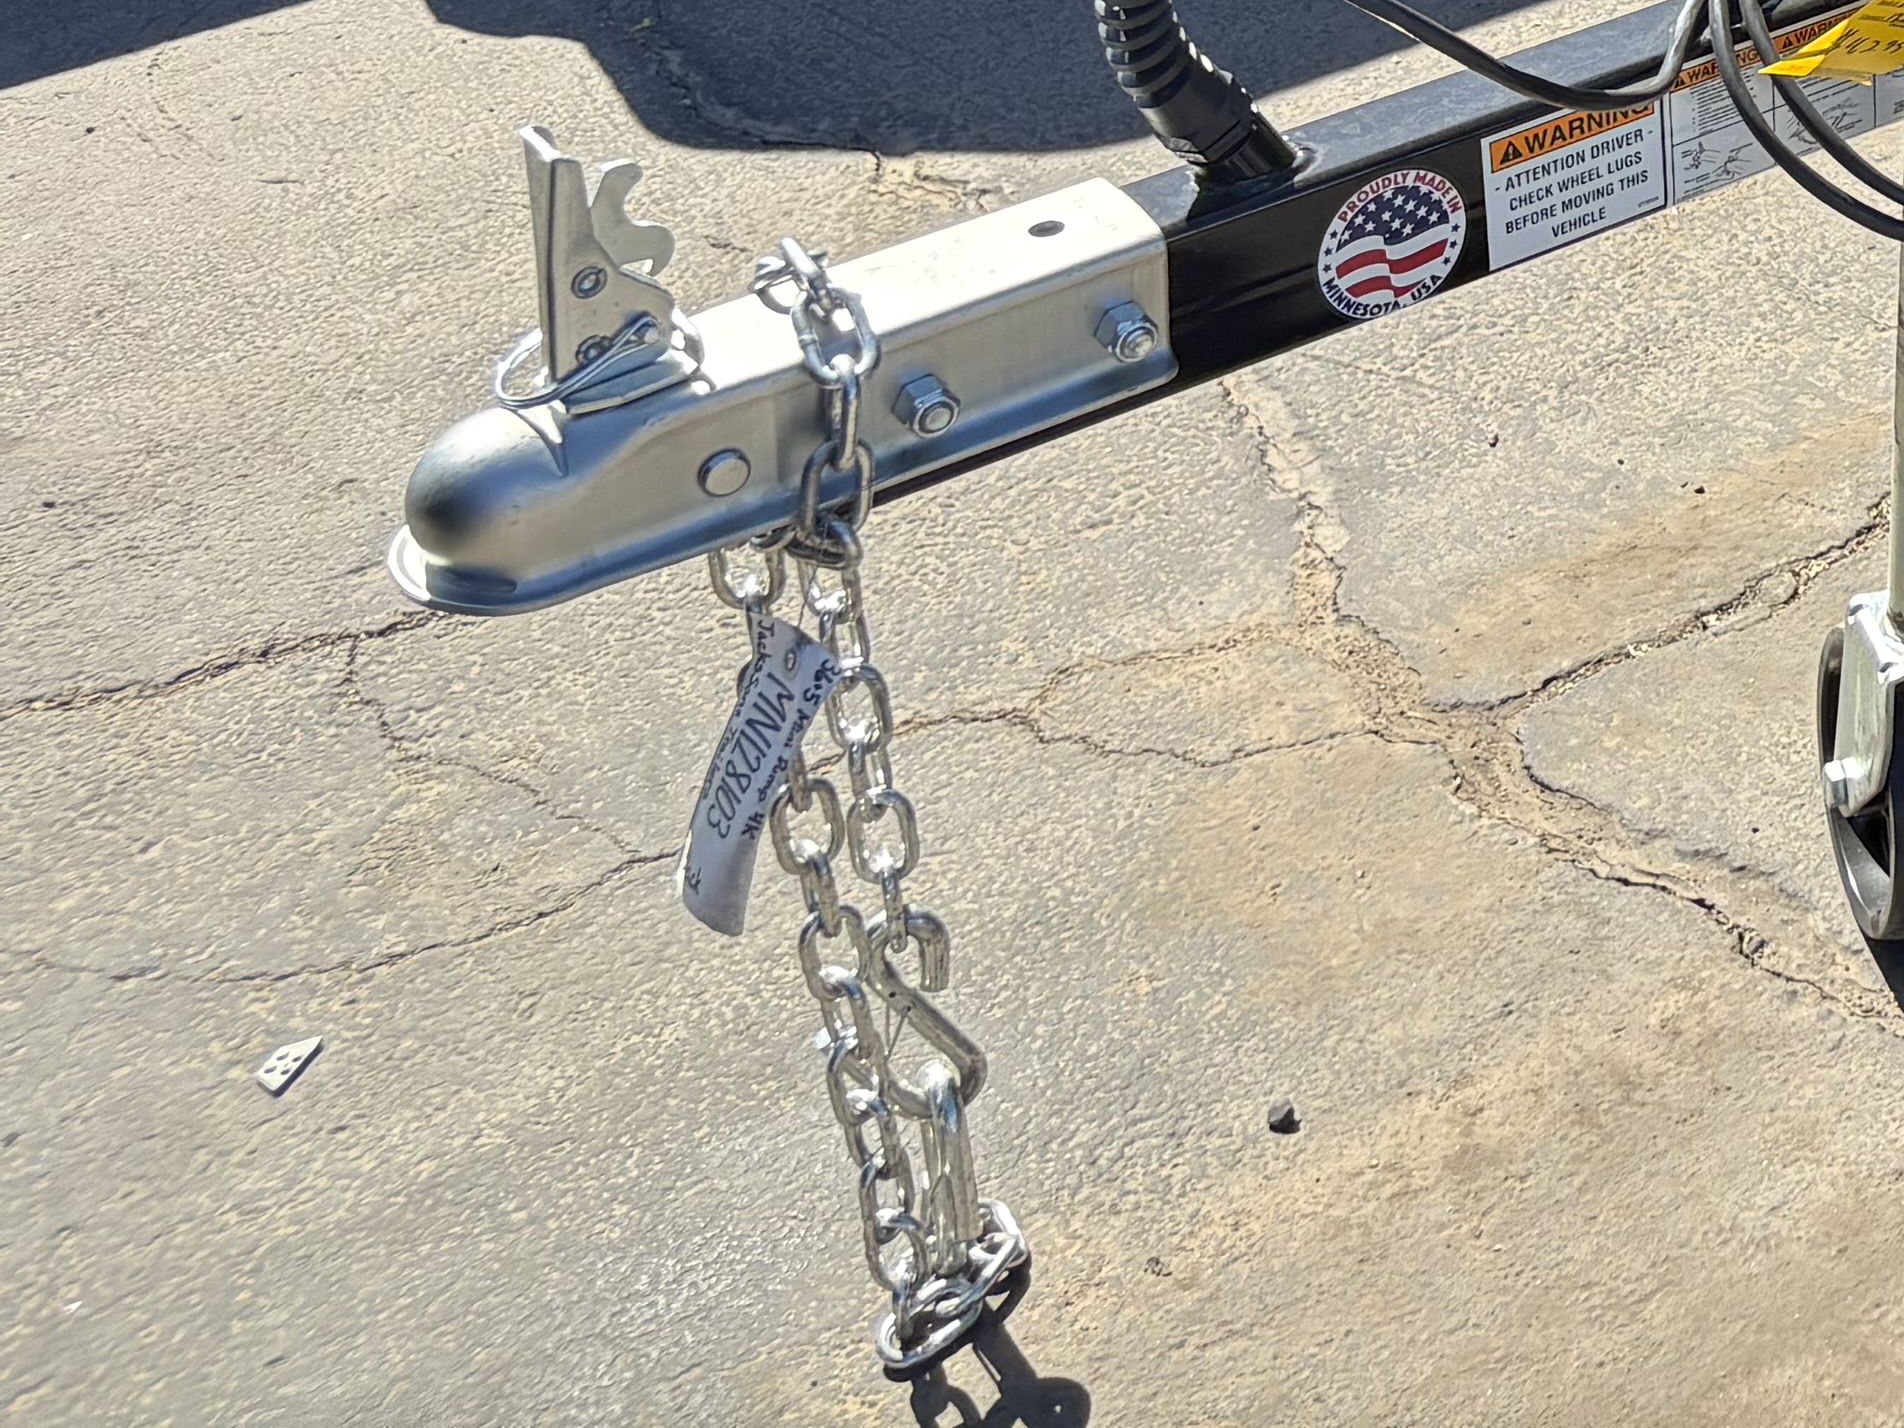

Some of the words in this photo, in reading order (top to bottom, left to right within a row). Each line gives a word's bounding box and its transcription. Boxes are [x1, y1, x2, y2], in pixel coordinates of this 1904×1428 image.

[1505, 149, 1586, 192] ATTENTION
[1590, 128, 1644, 160] DRIVER
[1509, 183, 1554, 212] CHECK
[1557, 165, 1604, 194] WHEEL
[1607, 150, 1643, 175] LUGS
[1338, 171, 1411, 223] PROUDLY
[1413, 170, 1450, 199] MADE
[1446, 195, 1463, 215] IN
[1505, 204, 1557, 235] BEFORE
[1561, 182, 1615, 214] MOVING
[1618, 169, 1649, 192] THIS
[1551, 206, 1607, 239] VEHICLE
[1410, 274, 1444, 302] USA
